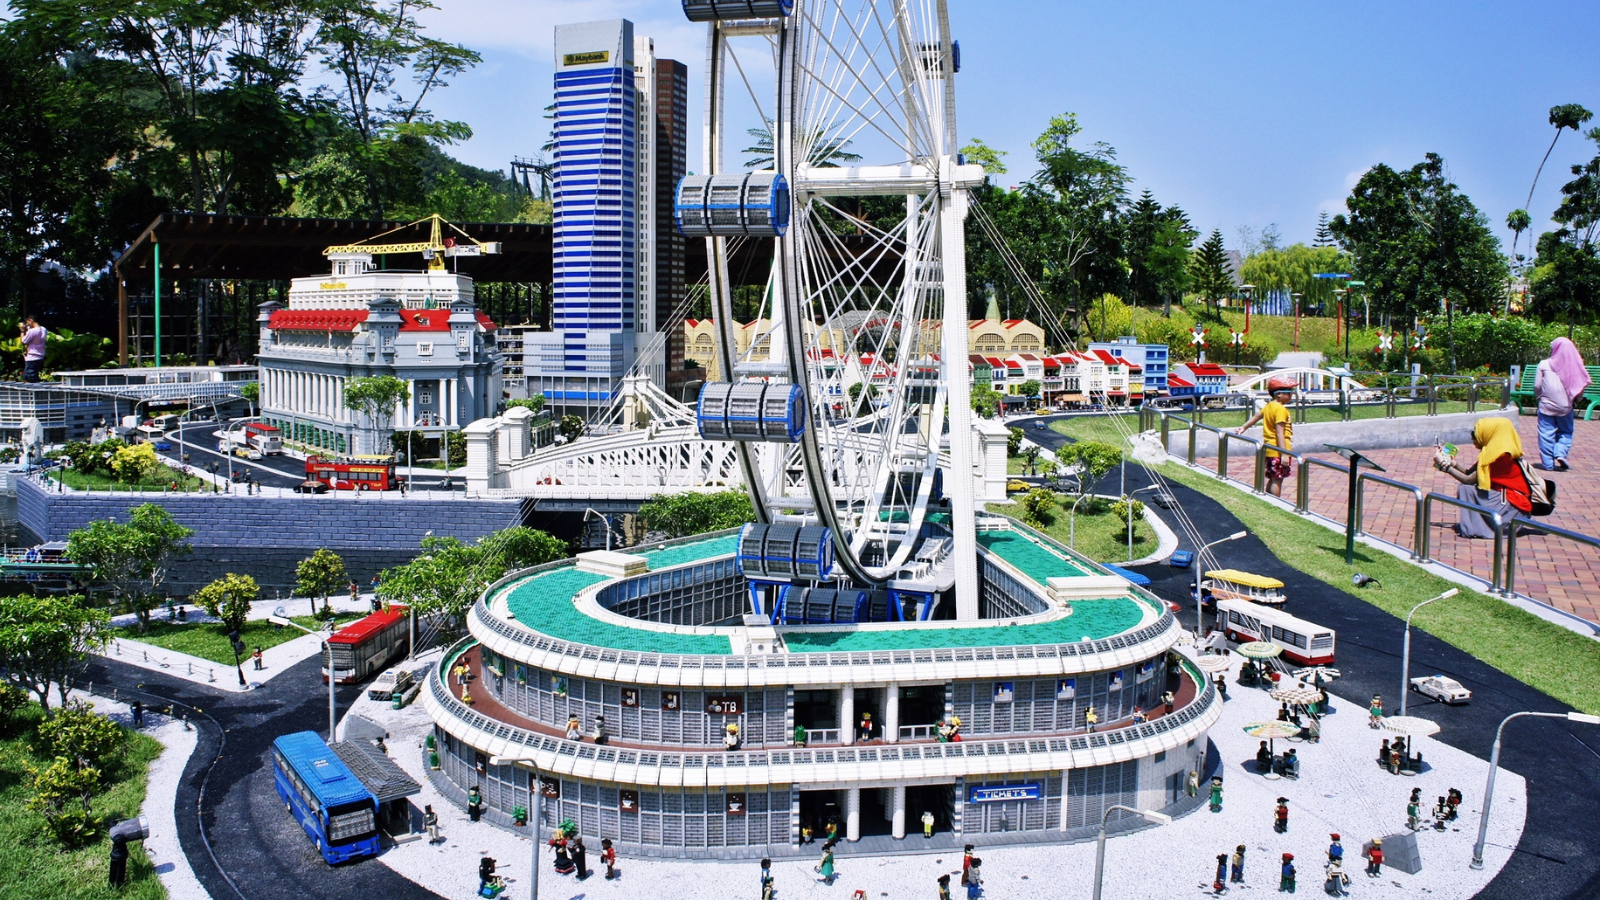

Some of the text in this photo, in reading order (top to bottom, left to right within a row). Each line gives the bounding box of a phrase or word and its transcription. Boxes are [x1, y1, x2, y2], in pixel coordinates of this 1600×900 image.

[575, 52, 604, 62] Maybank
[721, 701, 737, 713] TB
[983, 789, 1027, 799] TICKETS
